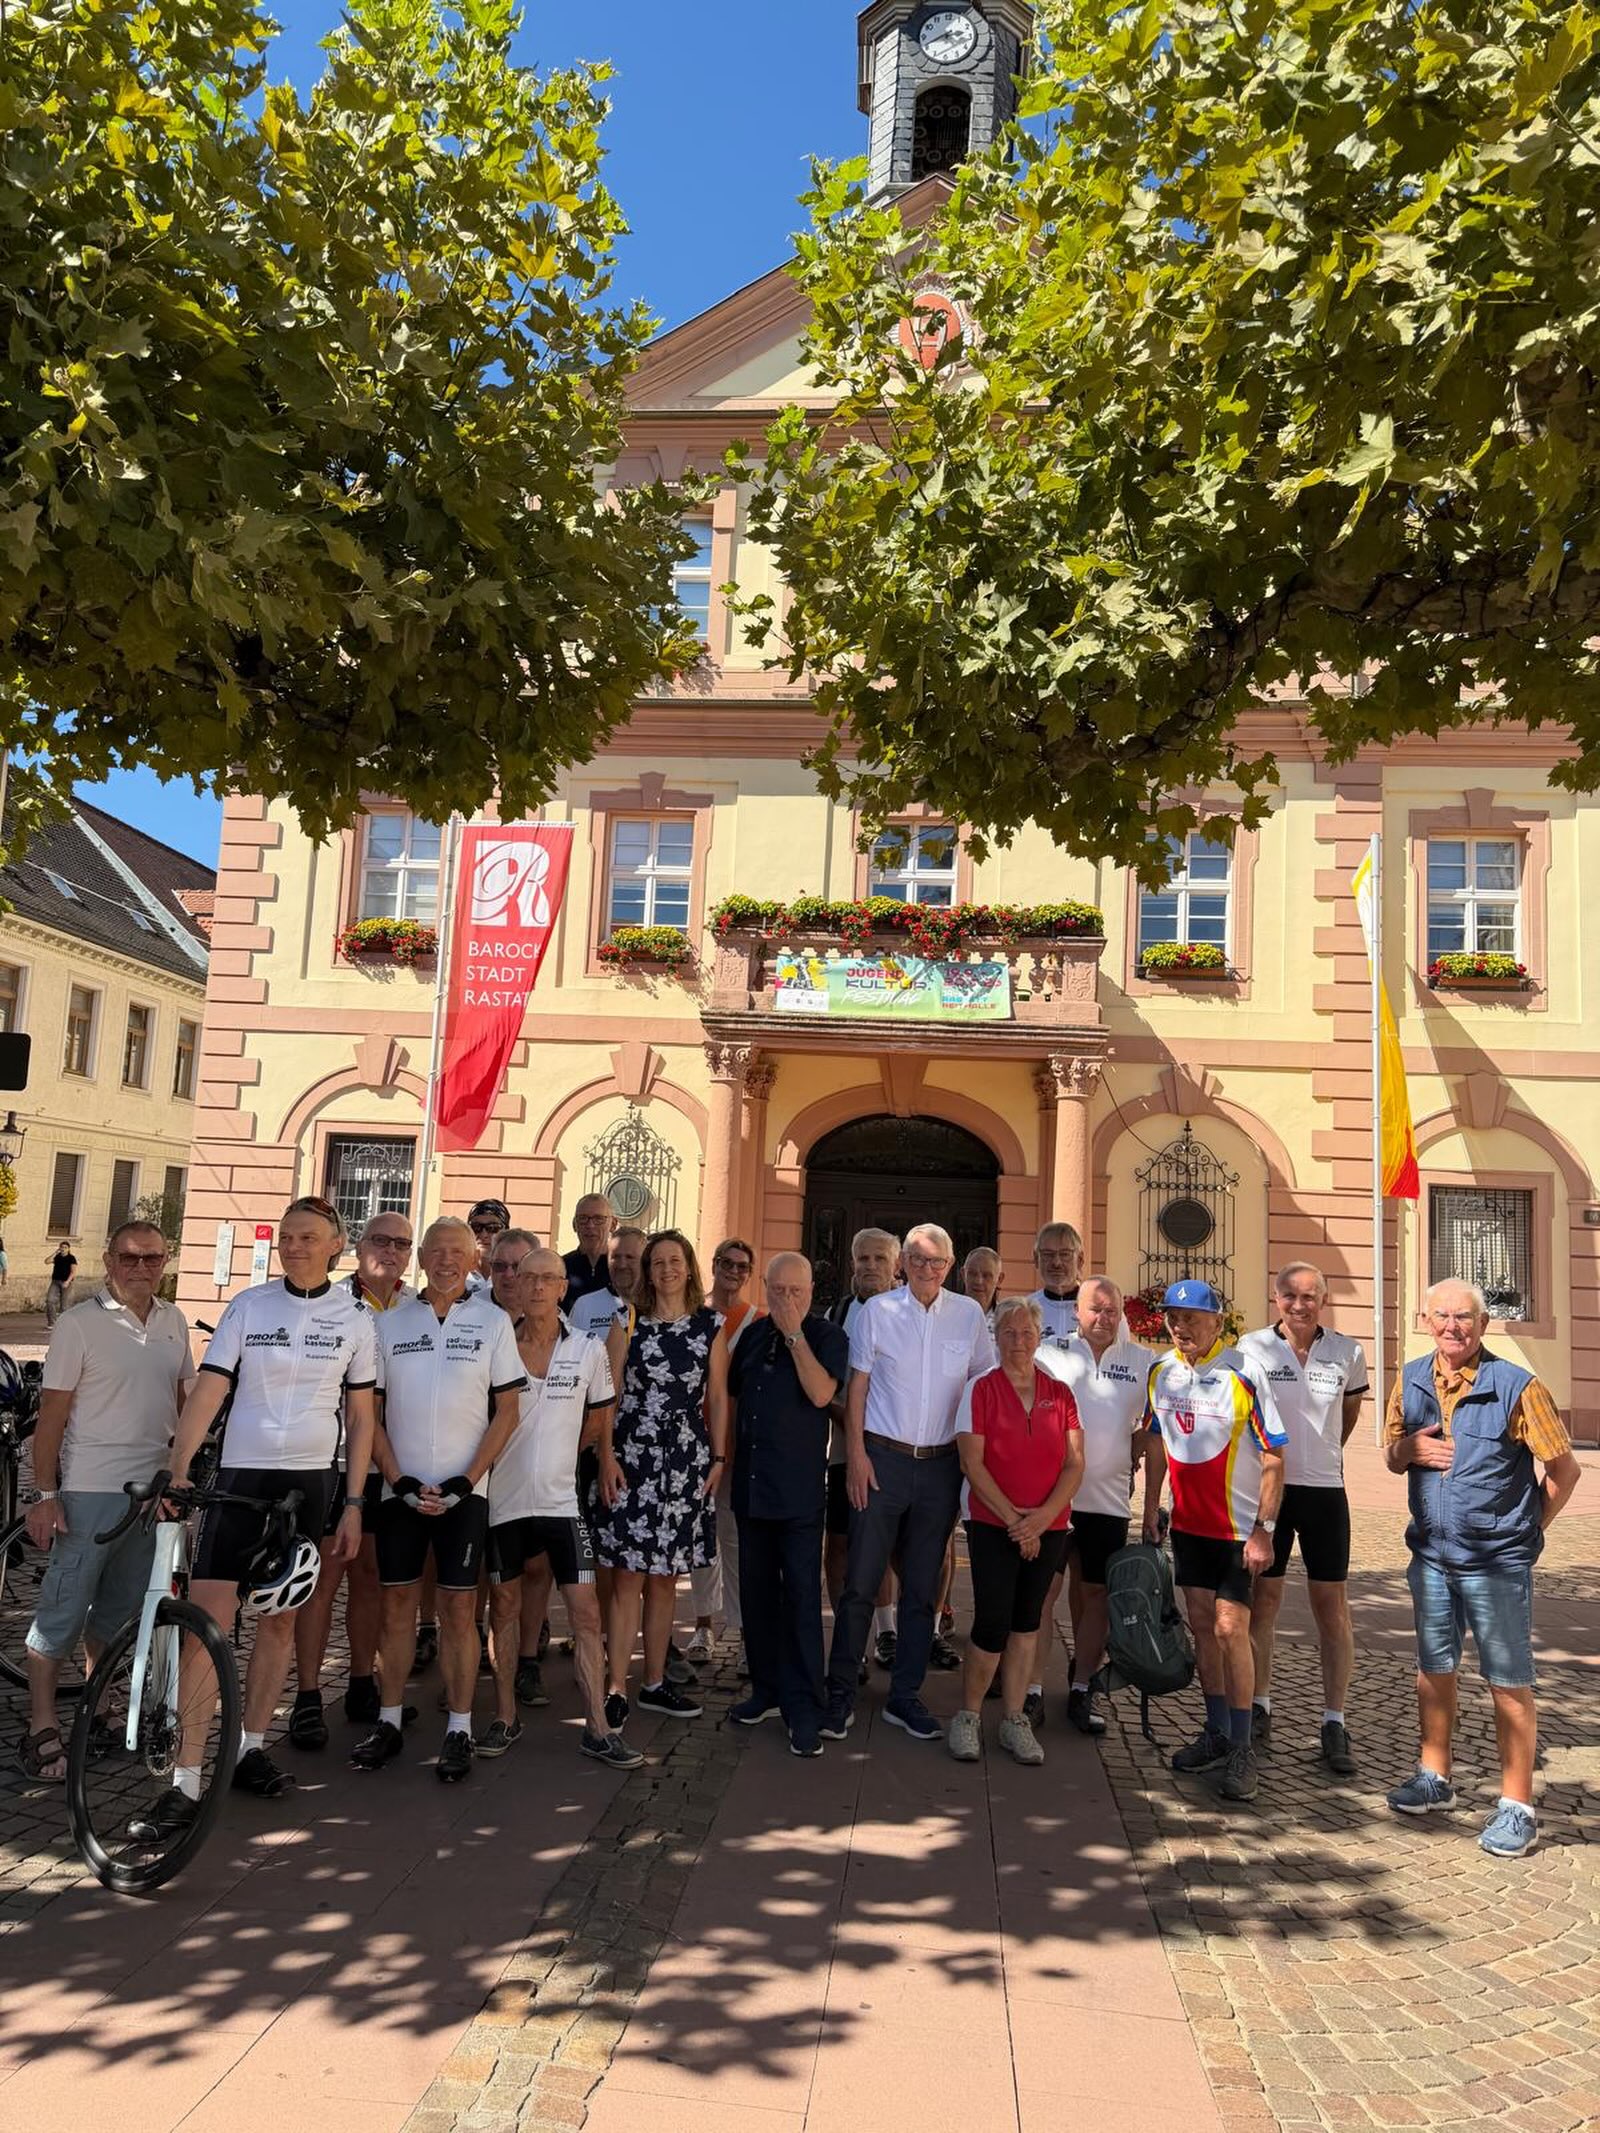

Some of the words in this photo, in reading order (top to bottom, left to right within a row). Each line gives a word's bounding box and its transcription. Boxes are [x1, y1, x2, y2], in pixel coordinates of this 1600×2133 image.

[465, 965, 527, 983] STADT
[1110, 1363, 1130, 1374] FIAT
[1102, 1370, 1138, 1383] TEMPRA
